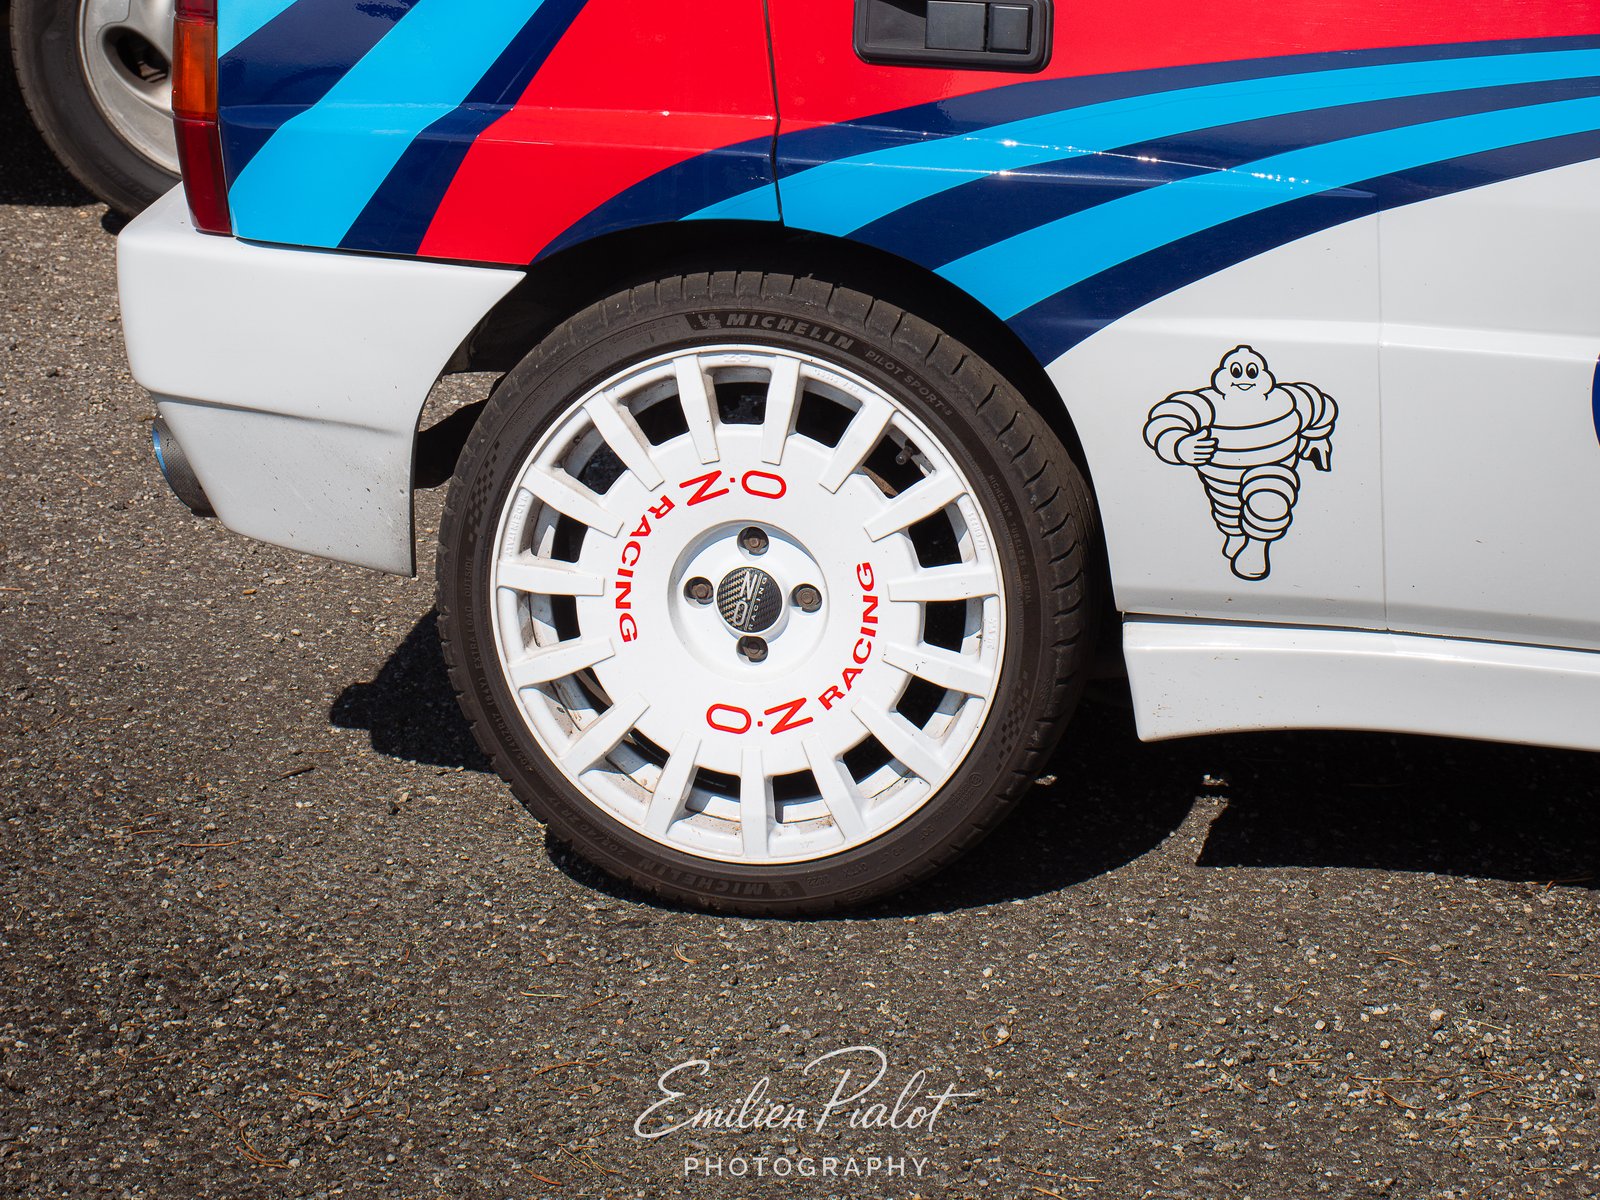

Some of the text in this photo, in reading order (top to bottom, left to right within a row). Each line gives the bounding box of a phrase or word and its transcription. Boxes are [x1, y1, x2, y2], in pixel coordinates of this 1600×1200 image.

[726, 313, 855, 350] MICHELIN
[864, 350, 903, 375] PILOT
[903, 372, 945, 410] SPORT
[615, 495, 675, 643] RACING
[748, 577, 767, 630] RACING
[818, 562, 878, 711] RACING
[638, 858, 764, 897] MICHELIN
